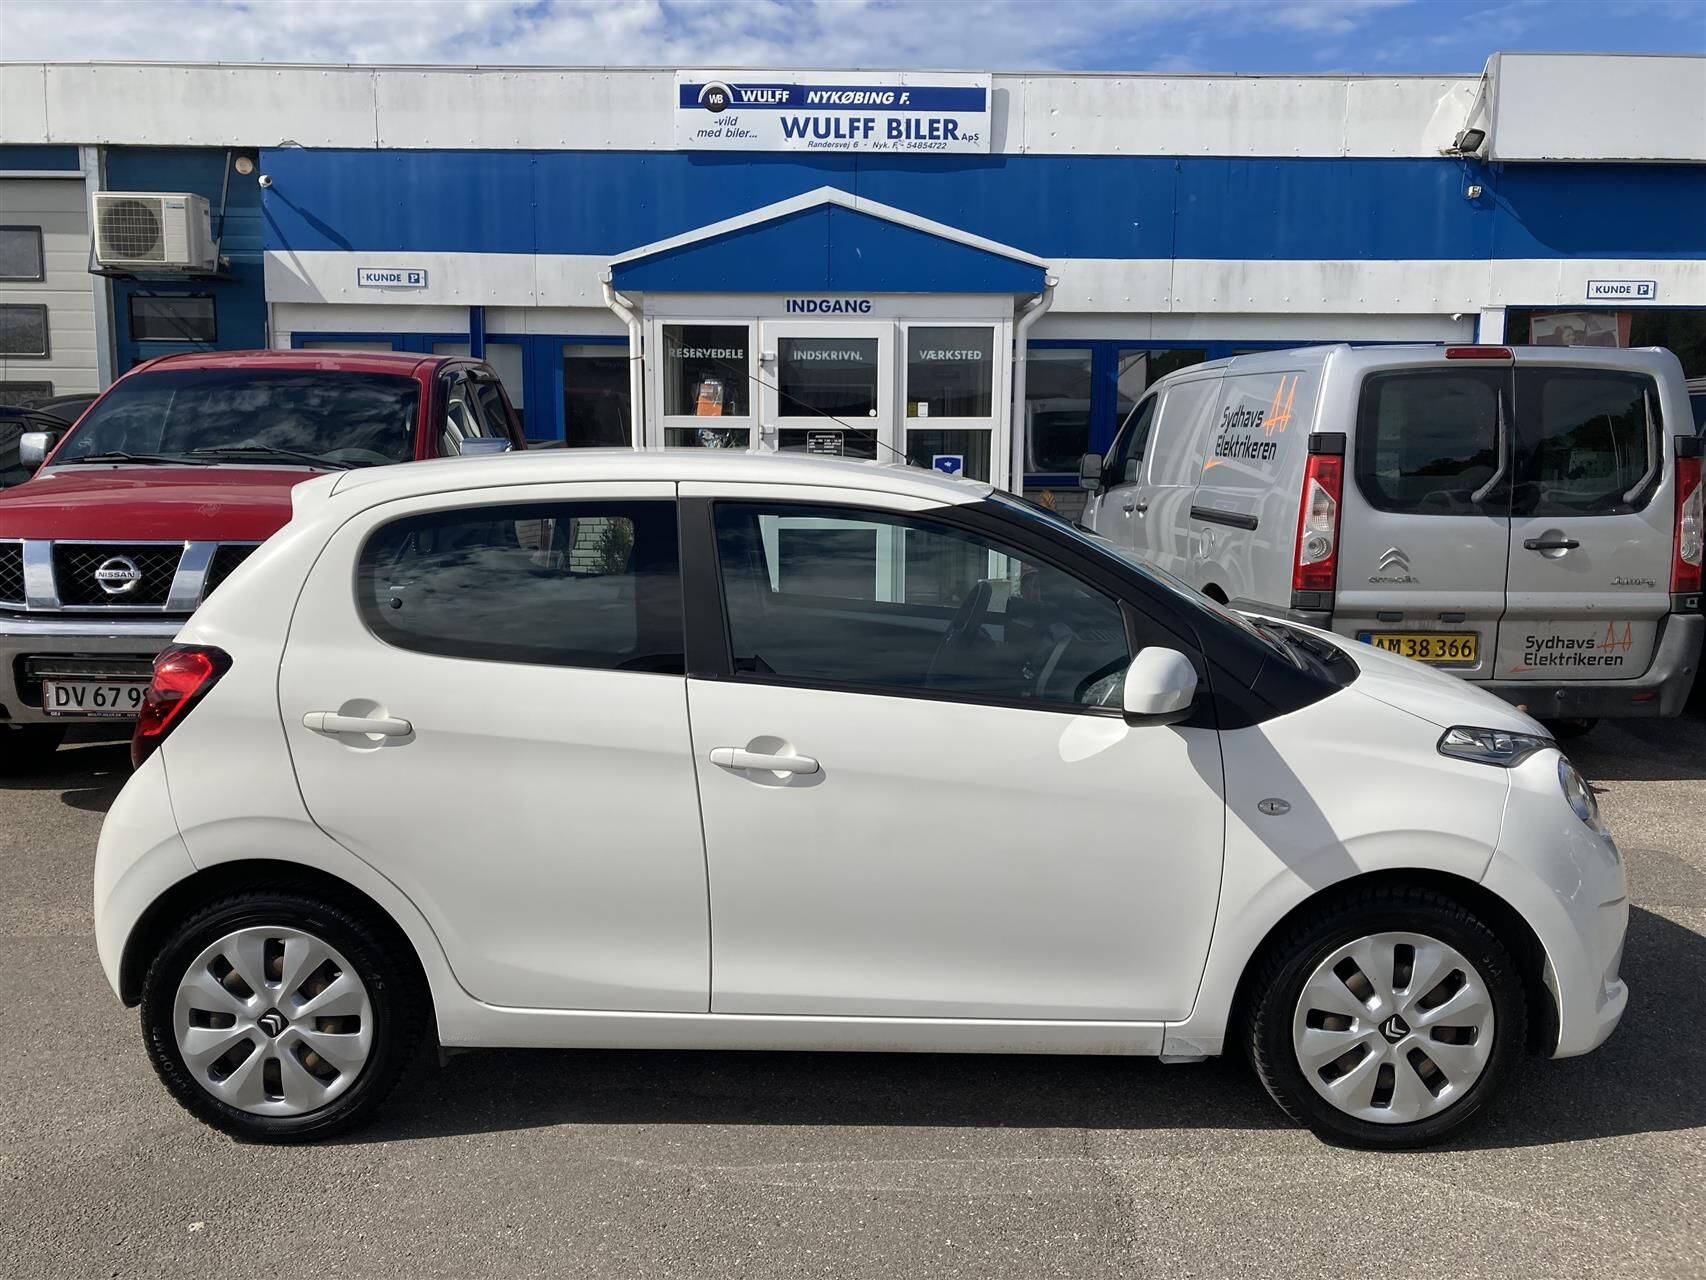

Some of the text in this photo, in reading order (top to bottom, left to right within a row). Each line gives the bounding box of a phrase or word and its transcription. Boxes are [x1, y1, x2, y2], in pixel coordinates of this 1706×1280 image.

[708, 94, 724, 104] WB
[741, 90, 790, 103] WULFF
[807, 90, 910, 105] NYKØBING F.
[714, 116, 738, 126] -vild
[697, 128, 758, 138] med biler...
[780, 116, 979, 143] WULFF BILER ApS
[807, 140, 850, 150] Randersvej
[872, 141, 890, 150] Nyk.
[366, 273, 402, 282] KUNDE
[1595, 285, 1631, 294] KUNDE
[786, 299, 872, 313] INDGANG
[668, 348, 744, 359] RESERVEDELE
[793, 350, 863, 361] INDSKRIVN.
[919, 350, 982, 361] VÆRKSTED
[1220, 405, 1264, 434] Sydhavs
[1215, 434, 1277, 460] Elektrikeren
[1375, 638, 1472, 658] AM 38 366
[1525, 635, 1595, 650] Sydhavs
[1524, 652, 1624, 666] Elektrikeren
[55, 686, 149, 708] DV 67 9
